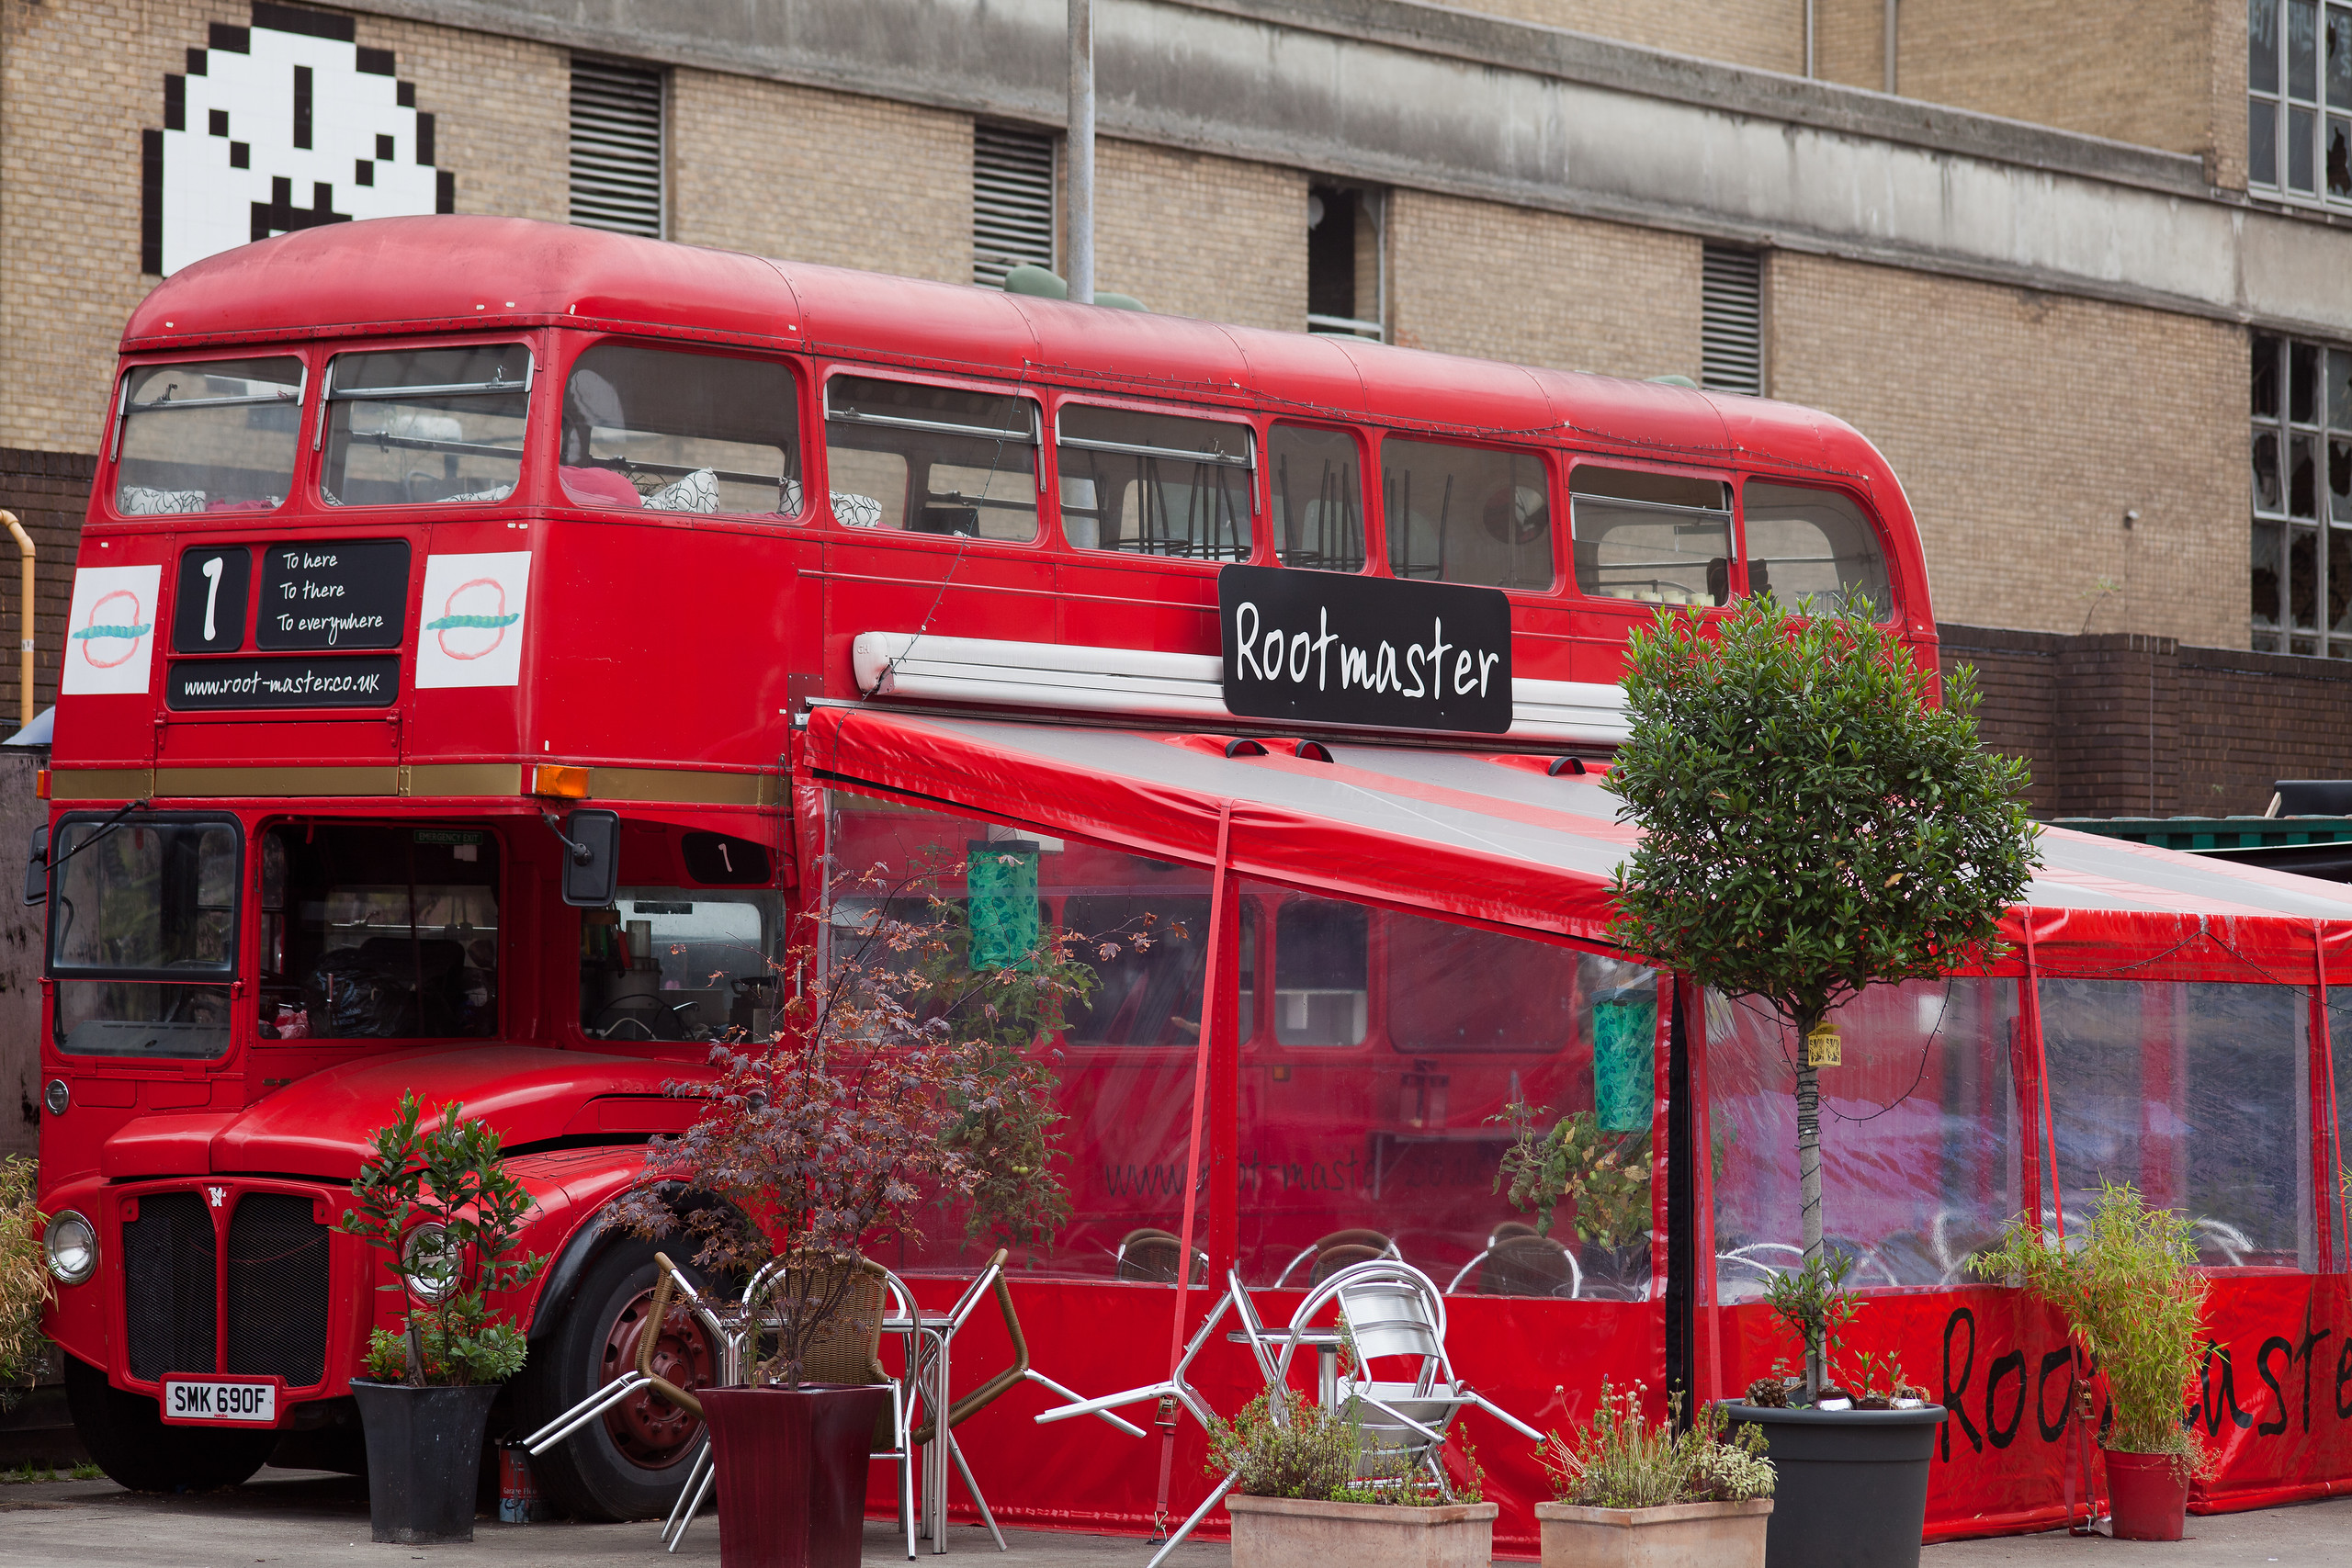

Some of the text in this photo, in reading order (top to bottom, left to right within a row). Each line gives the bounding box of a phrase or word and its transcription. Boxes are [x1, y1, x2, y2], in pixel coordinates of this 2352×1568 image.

[283, 553, 338, 570] To here
[202, 557, 223, 641] 1
[279, 580, 345, 599] To there
[277, 613, 384, 646] To everywhere
[1237, 602, 1498, 700] Rootmaster
[185, 670, 380, 695] www.root-master.co.uk
[418, 832, 479, 842] EMERGENCY EXIT
[718, 843, 732, 872] 1
[175, 1386, 266, 1414] SMK 690F
